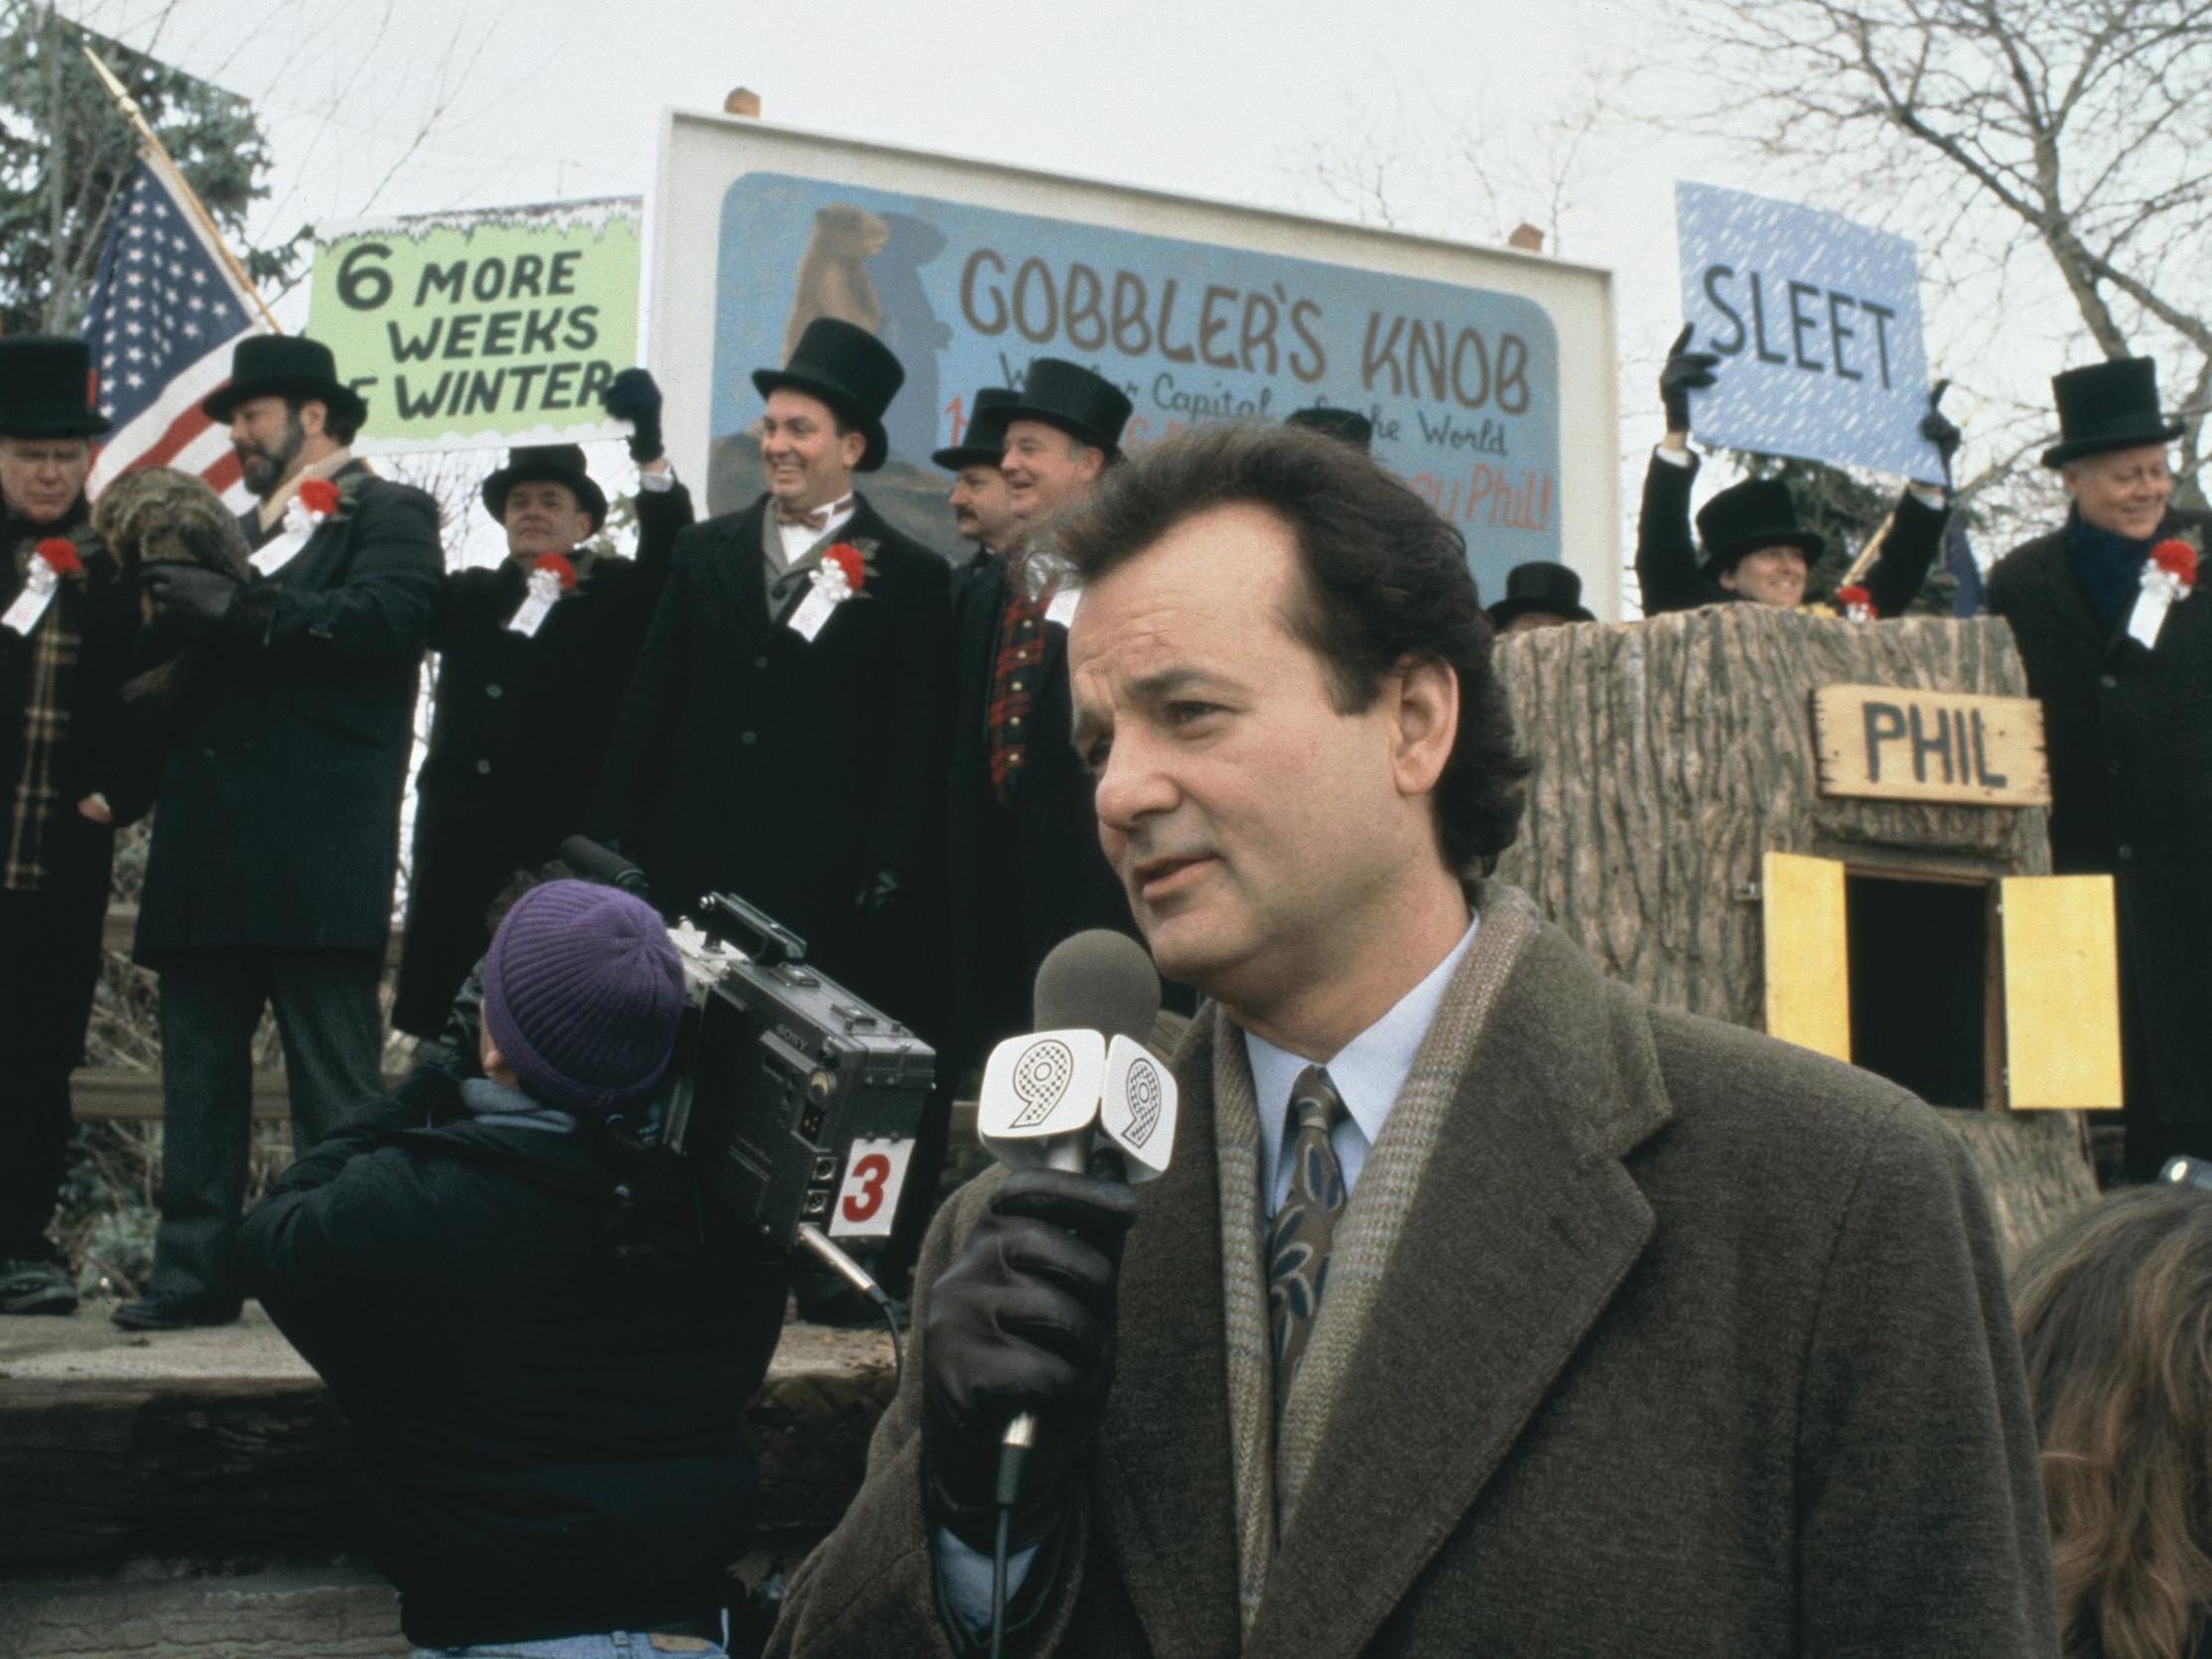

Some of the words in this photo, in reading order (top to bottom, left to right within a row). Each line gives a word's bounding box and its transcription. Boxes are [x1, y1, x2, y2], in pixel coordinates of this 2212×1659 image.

[337, 243, 393, 311] 6
[414, 251, 582, 307] MORE
[387, 305, 600, 363] WEEKS
[959, 248, 1324, 383] GOBBLER'S
[1361, 310, 1531, 415] KNOB
[1702, 264, 1895, 389] SLEET
[394, 359, 614, 420] WINTER
[1417, 408, 1510, 458] World
[1862, 702, 2007, 788] PHIL
[1009, 1038, 1075, 1129] 9
[1119, 1057, 1161, 1149] 9
[841, 1153, 892, 1223] 3
